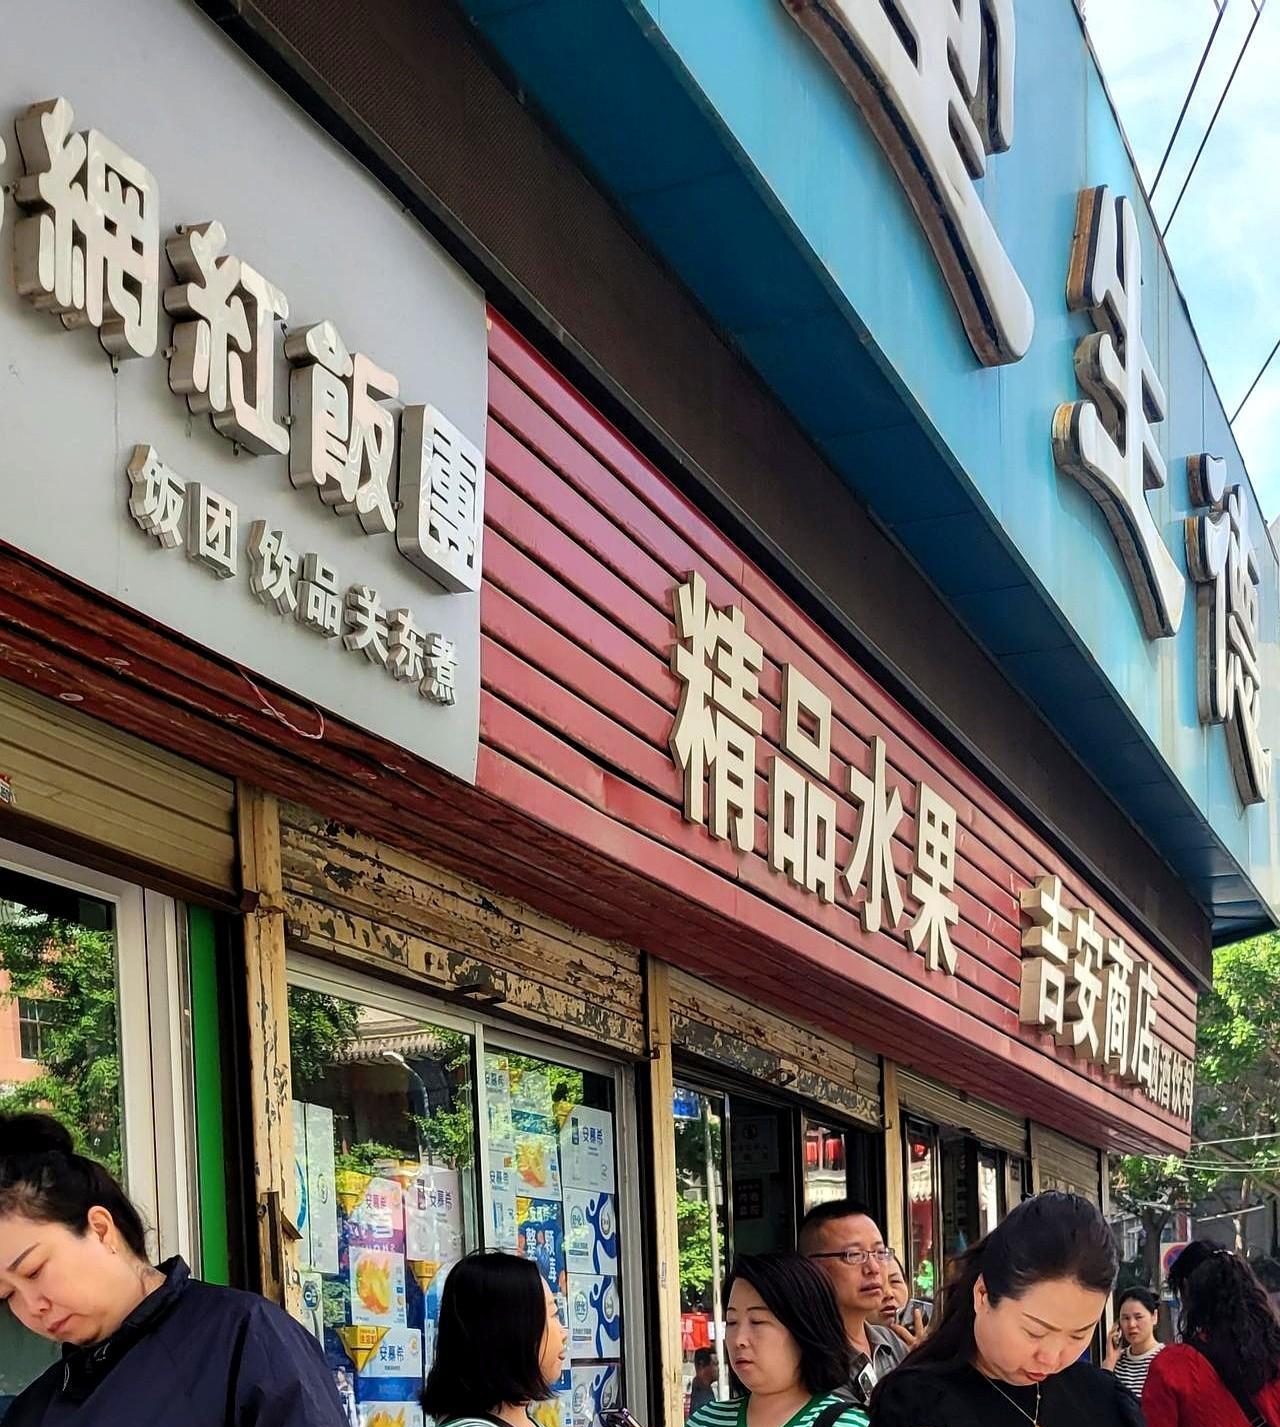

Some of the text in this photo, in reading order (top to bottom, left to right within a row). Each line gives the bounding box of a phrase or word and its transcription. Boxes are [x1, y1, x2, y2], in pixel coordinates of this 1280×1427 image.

[0, 97, 483, 593] 網紅飯團
[128, 444, 238, 580] 饭团
[343, 583, 457, 706] 关东煮
[669, 570, 959, 976] 精品水果
[1021, 875, 1159, 1086] 吉安商店
[582, 1126, 603, 1145] 安慕希
[380, 1344, 405, 1362] 安慕希
